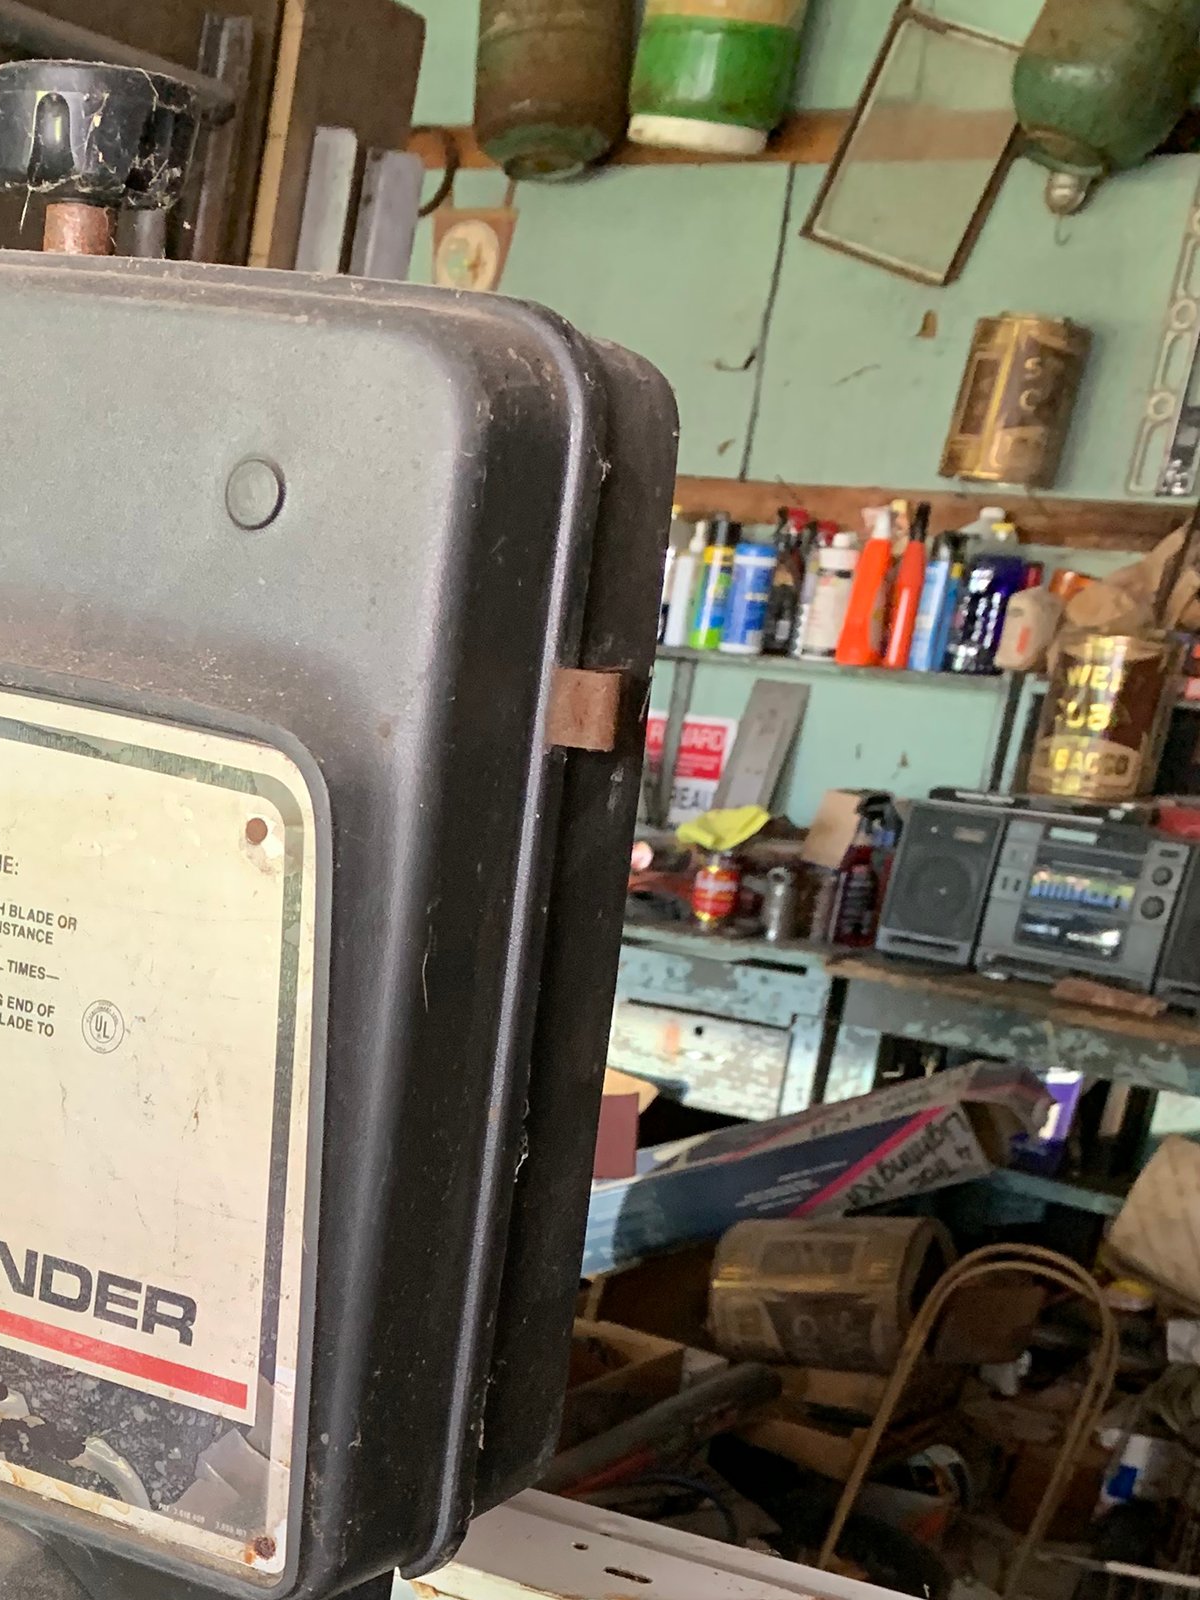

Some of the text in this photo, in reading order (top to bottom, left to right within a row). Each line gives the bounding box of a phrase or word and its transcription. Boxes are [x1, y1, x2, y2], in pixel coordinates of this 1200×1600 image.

[8, 903, 54, 927] BLADE
[57, 914, 78, 933] OR
[6, 995, 36, 1016] END
[34, 1002, 56, 1018] OF
[37, 1020, 55, 1038] TO
[94, 1014, 110, 1040] UL
